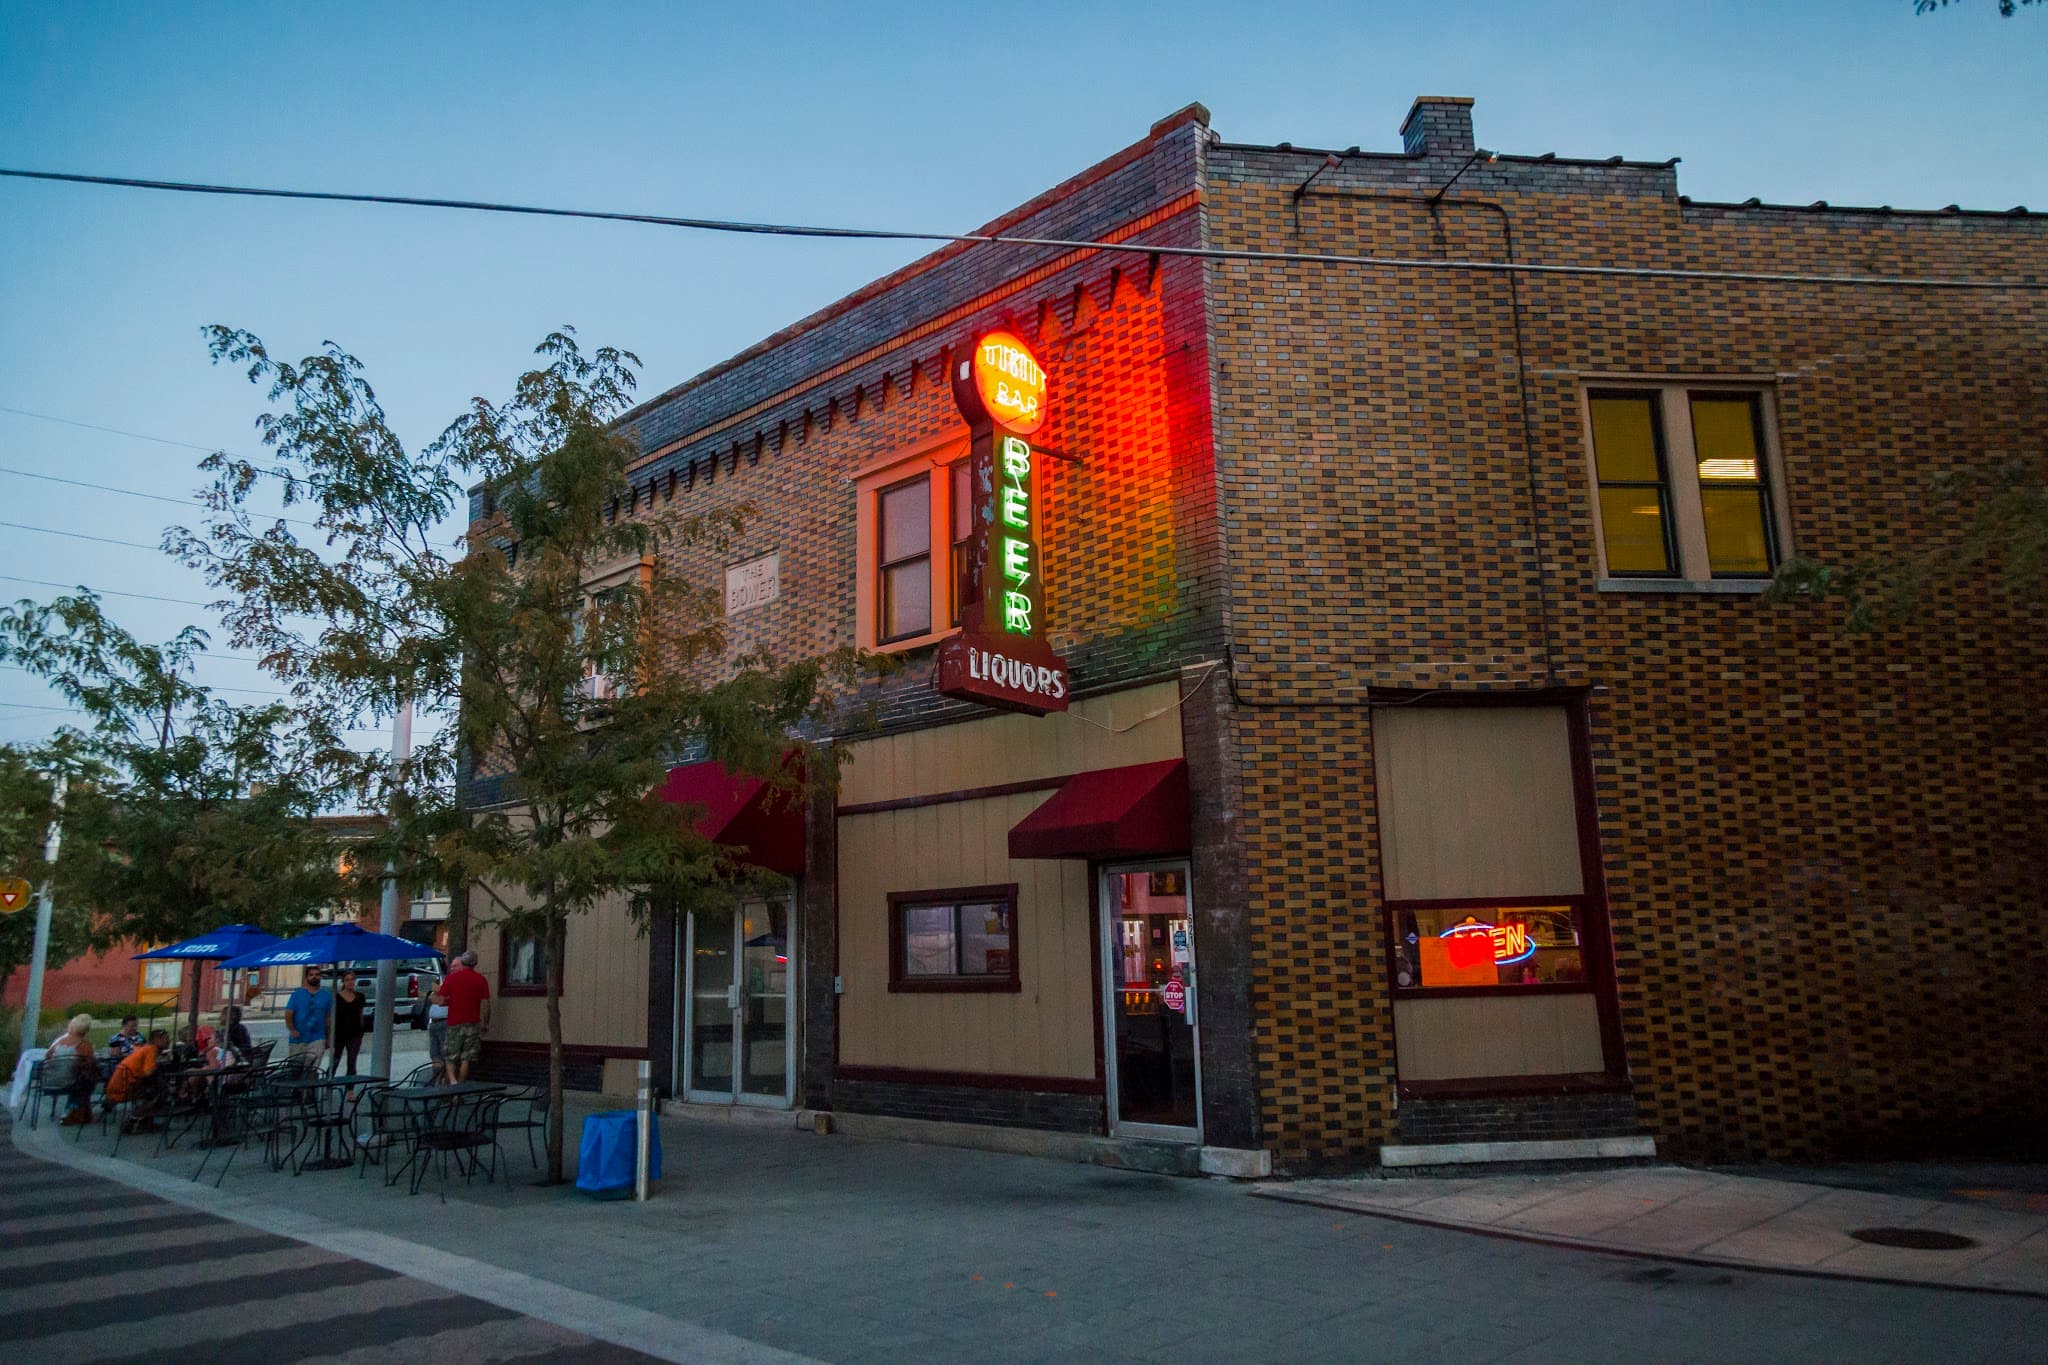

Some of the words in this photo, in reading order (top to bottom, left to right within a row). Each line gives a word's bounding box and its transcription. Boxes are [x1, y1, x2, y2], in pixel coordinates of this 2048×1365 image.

[996, 381, 1037, 419] BAR
[1003, 436, 1032, 637] BEER
[968, 647, 1064, 698] LIQUORS
[1165, 991, 1184, 1000] STOP
